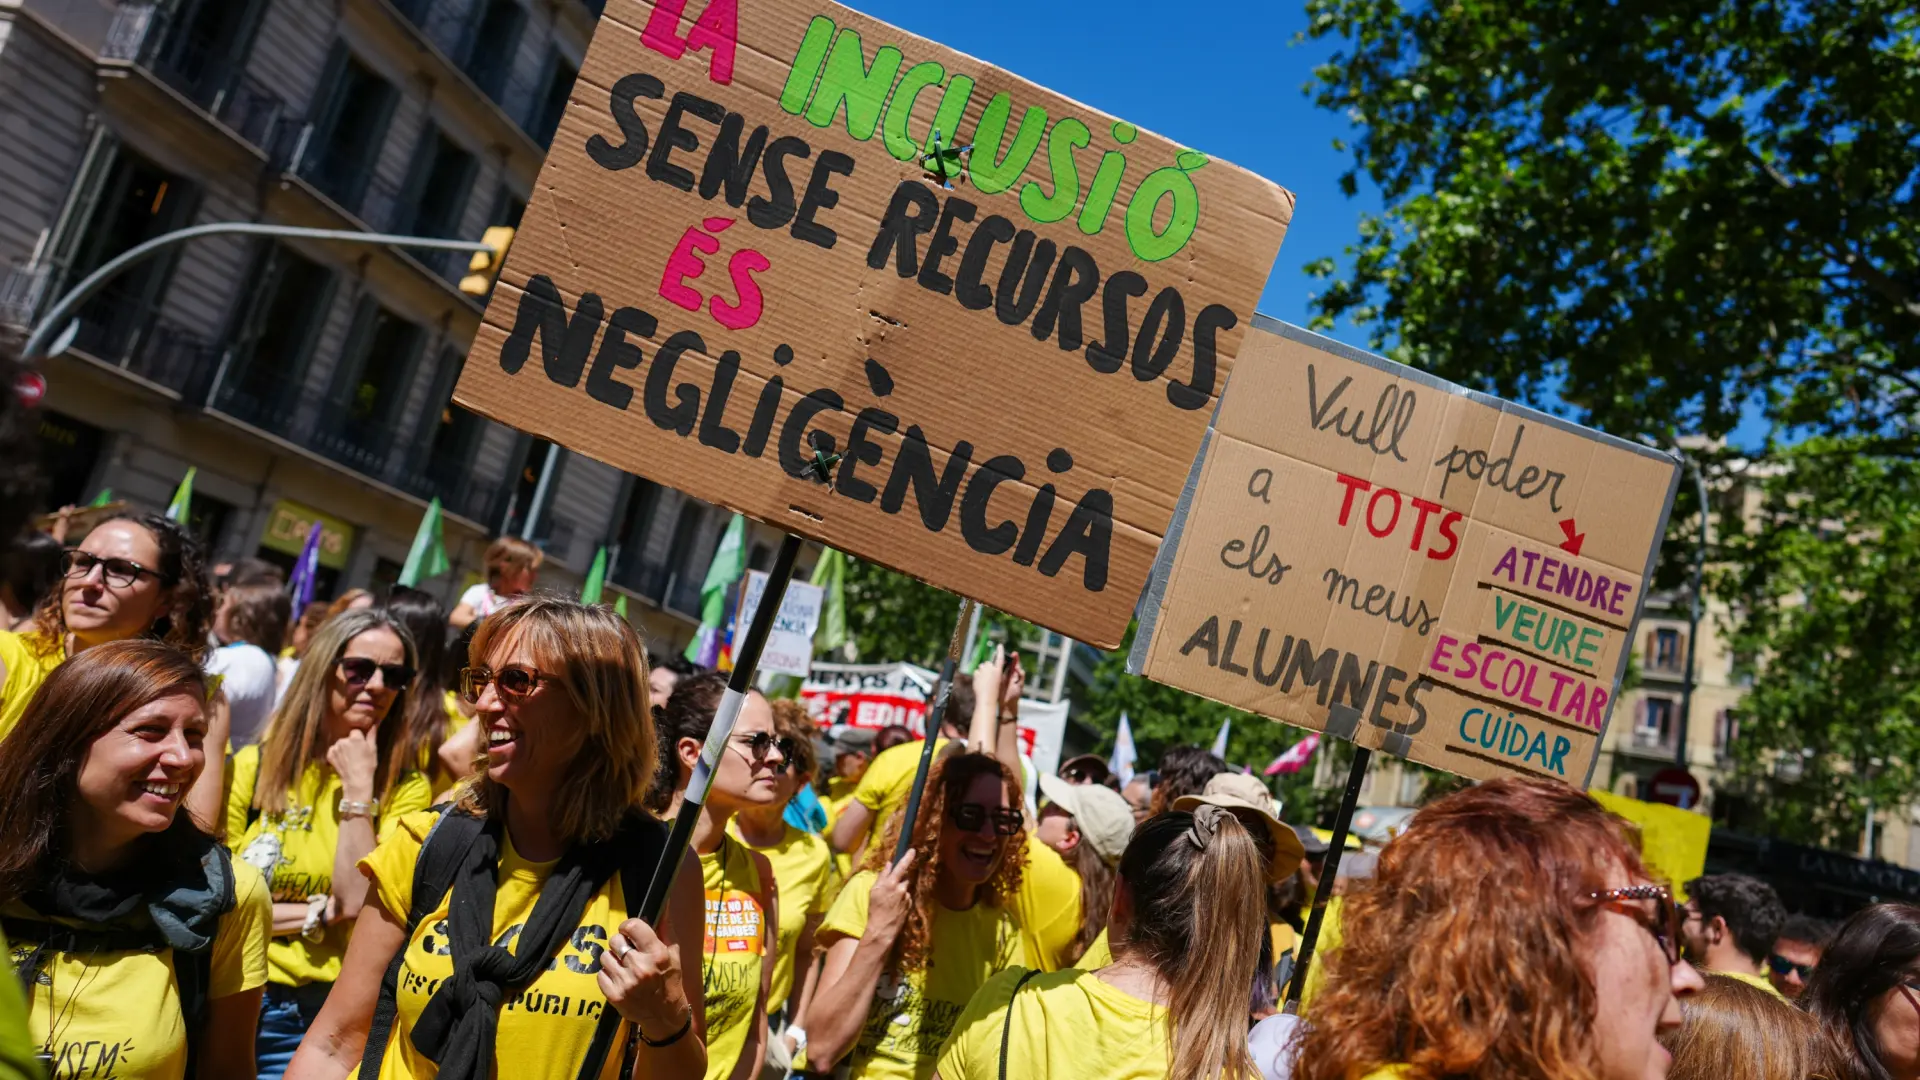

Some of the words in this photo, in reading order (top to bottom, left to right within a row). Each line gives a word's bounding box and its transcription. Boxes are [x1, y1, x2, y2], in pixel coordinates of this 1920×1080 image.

[640, 0, 738, 86] LA
[586, 74, 856, 250] SENSE
[867, 181, 1238, 411] RECURSOS
[658, 217, 771, 329] ÉS
[1307, 364, 1416, 462] Vull
[1435, 424, 1566, 513] poder
[1248, 468, 1273, 504] a
[1336, 472, 1463, 561] TOTS
[1220, 525, 1292, 585] els
[1322, 568, 1440, 636] meus
[1492, 546, 1632, 616] ATENDRE
[1179, 615, 1433, 736] ALUMNES
[1495, 595, 1604, 668] VEURE
[856, 700, 926, 737] EDUC
[1430, 635, 1608, 731] ESCOLTAR
[705, 911, 729, 925] ACTE
[727, 899, 743, 913] NO
[507, 988, 603, 1021] PÚBLIC
